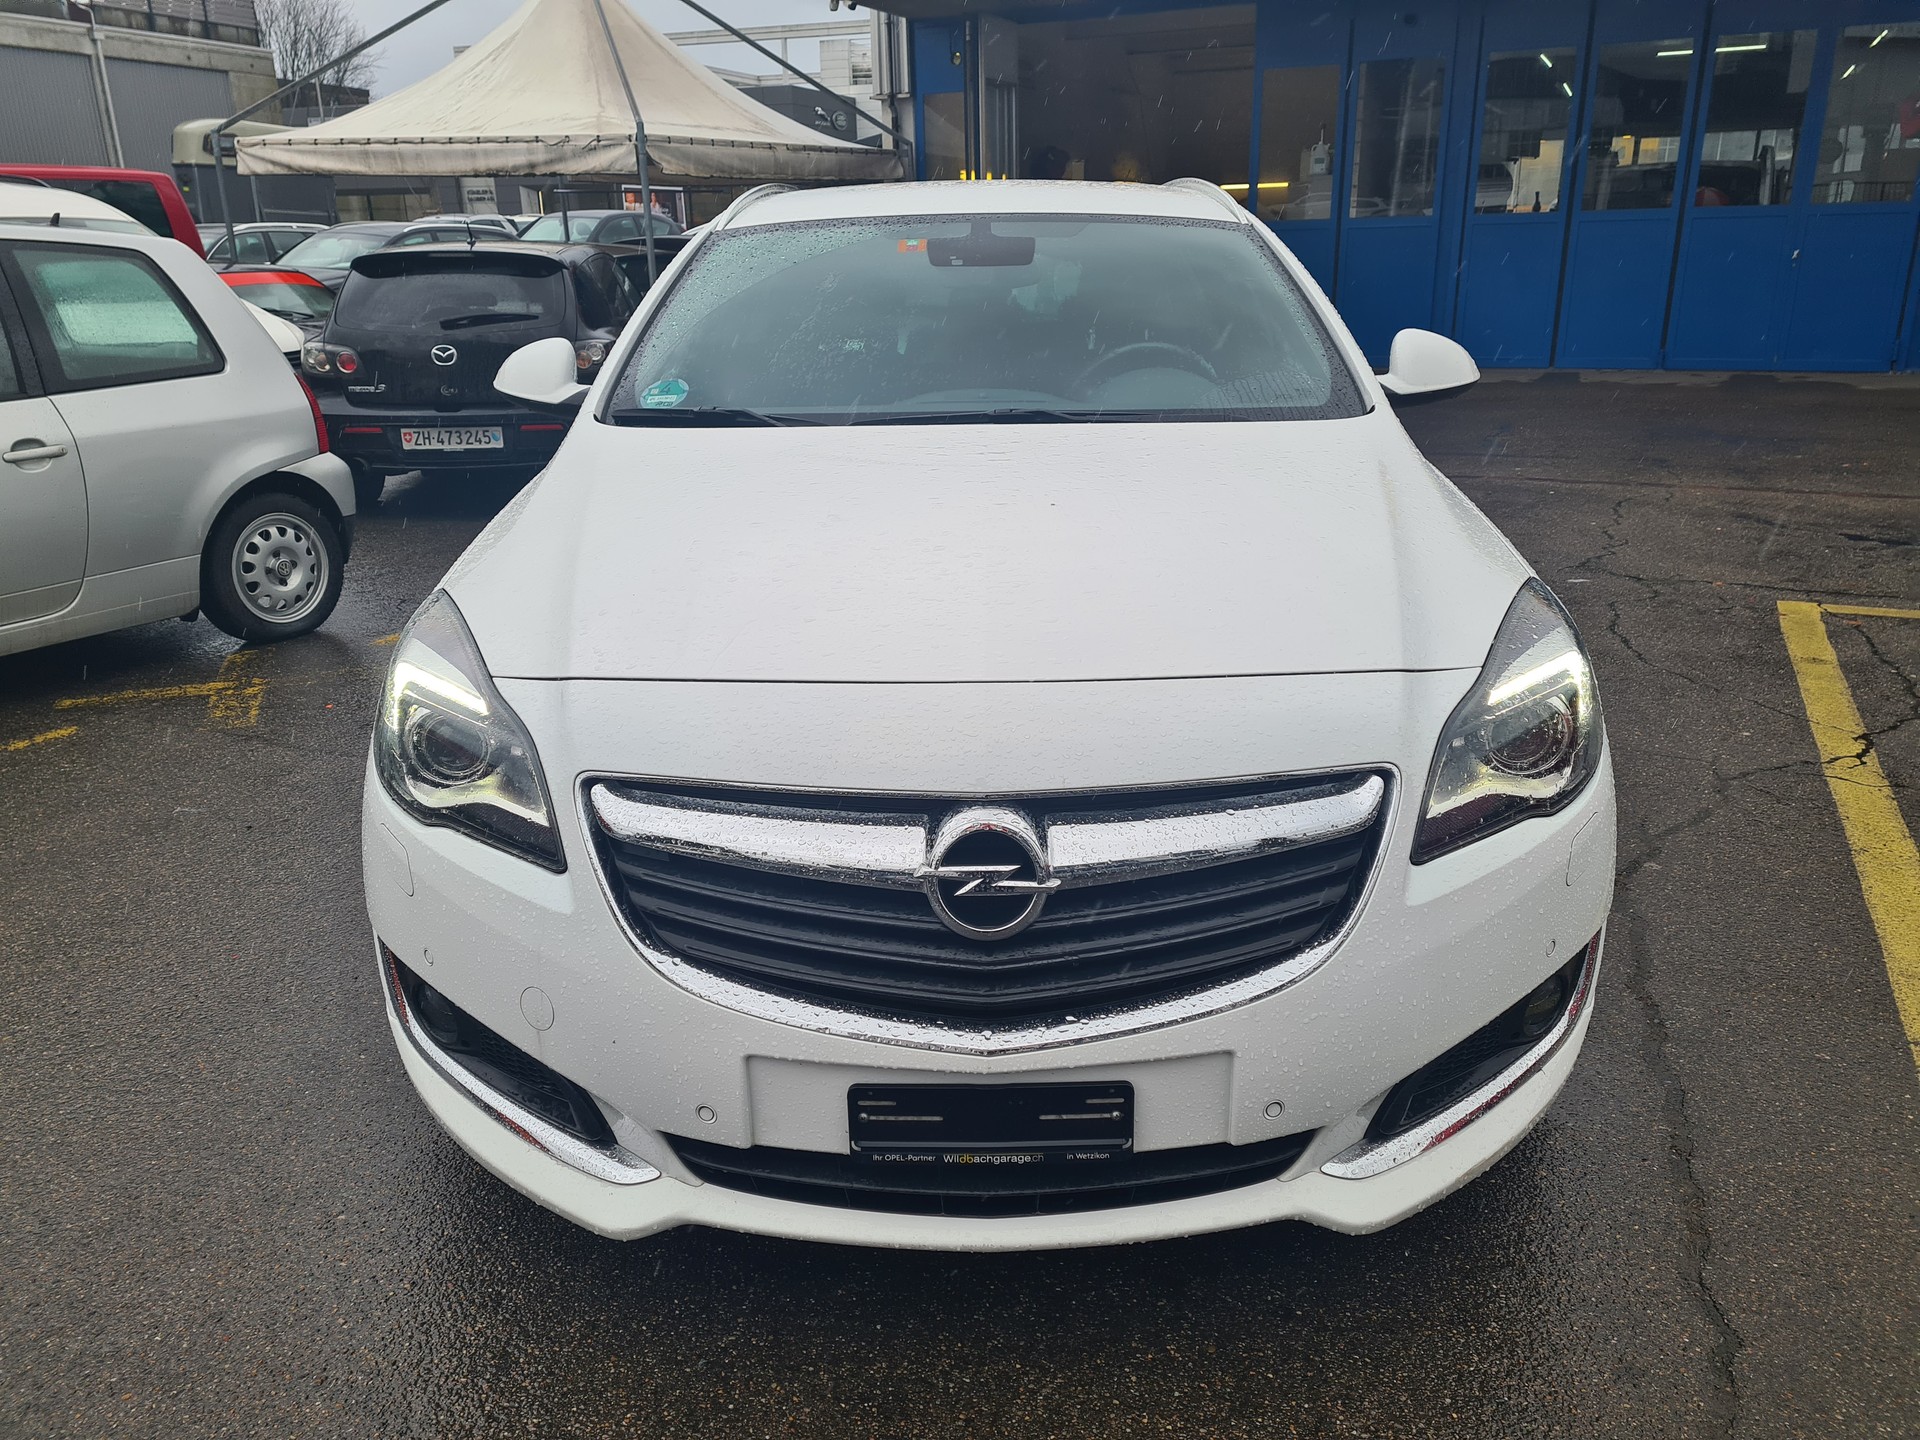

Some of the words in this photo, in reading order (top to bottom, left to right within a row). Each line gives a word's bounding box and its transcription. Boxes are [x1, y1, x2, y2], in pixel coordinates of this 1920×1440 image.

[884, 1154, 937, 1162] OPEL-Partner
[943, 1154, 1044, 1165] Wildbachgarage.ch
[1076, 1152, 1110, 1160] Wetzikon
